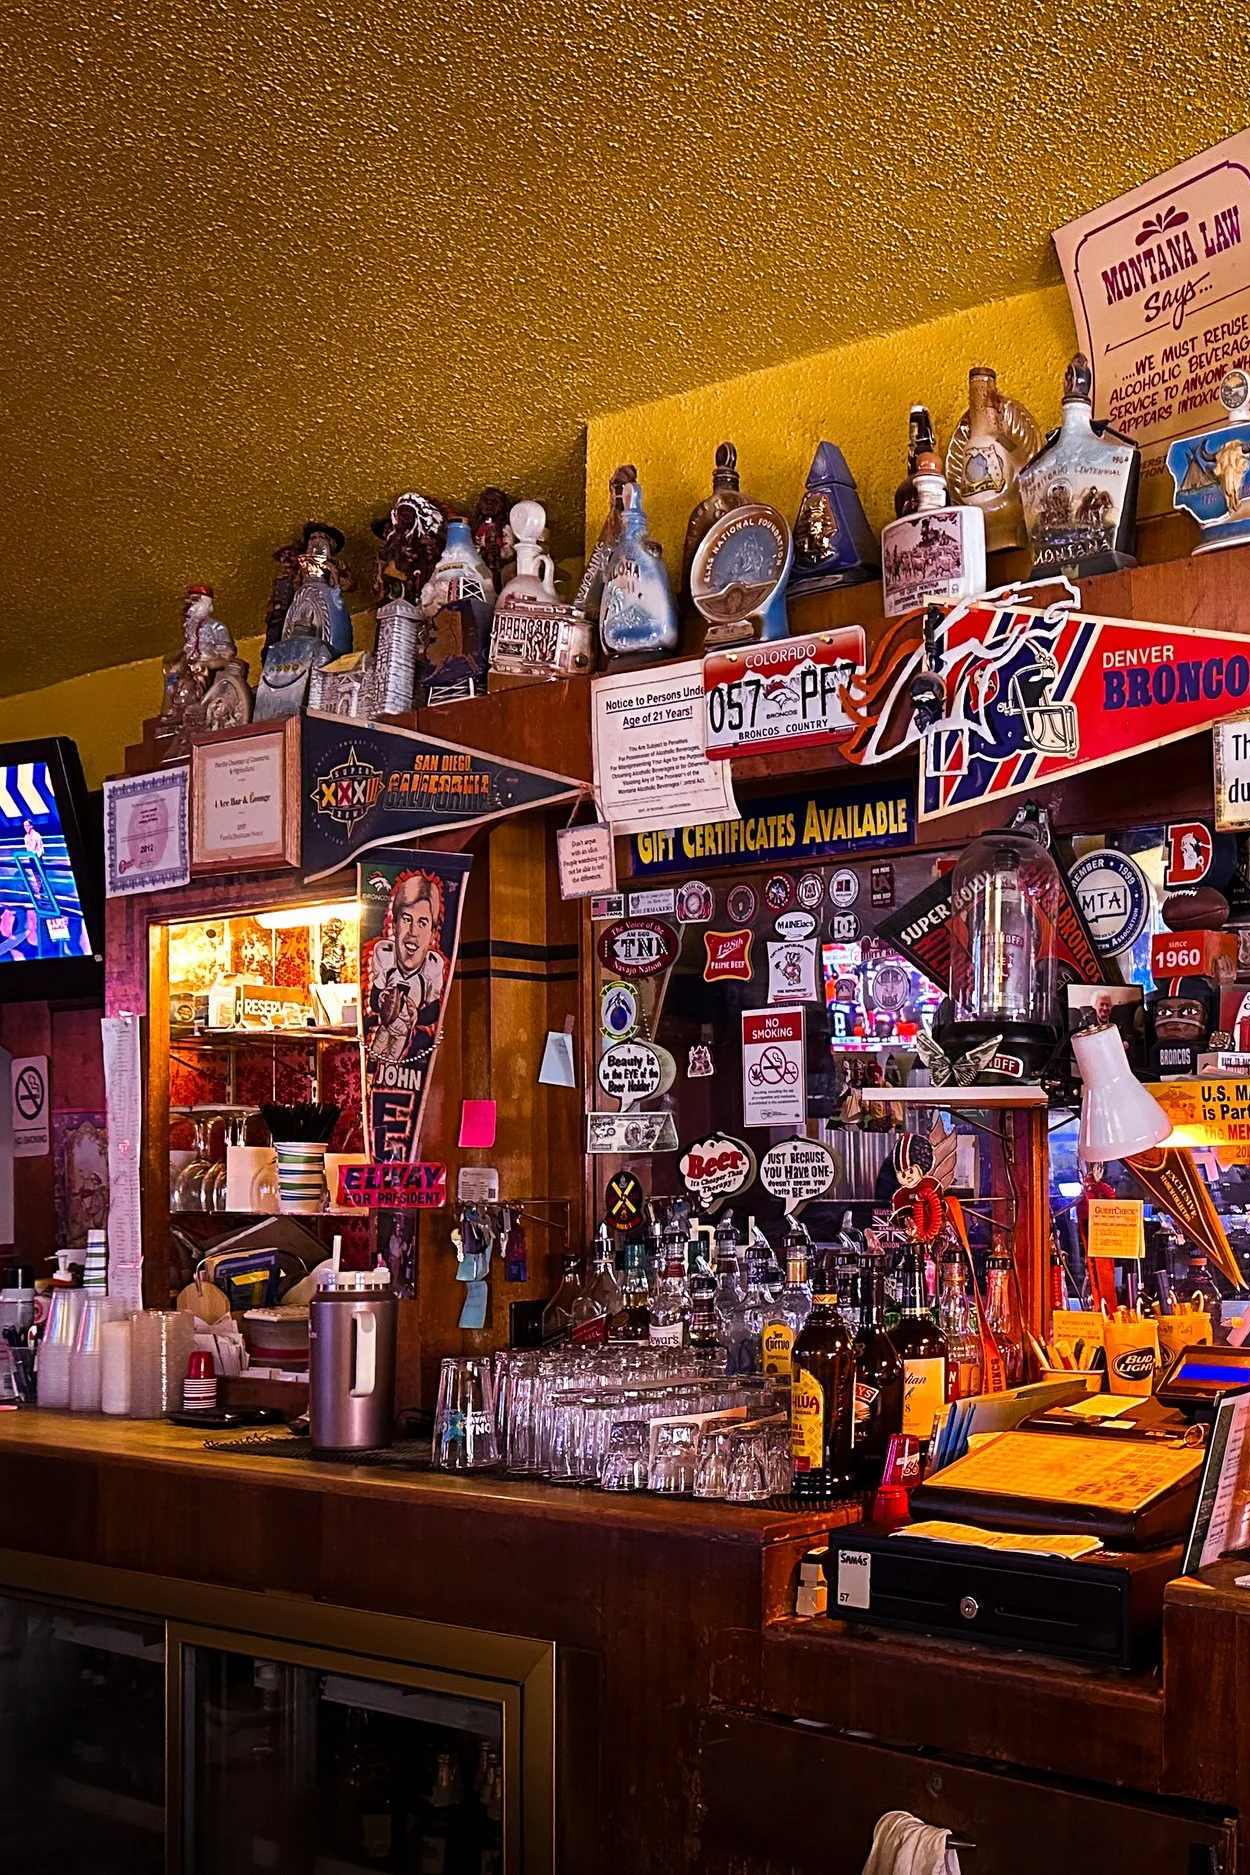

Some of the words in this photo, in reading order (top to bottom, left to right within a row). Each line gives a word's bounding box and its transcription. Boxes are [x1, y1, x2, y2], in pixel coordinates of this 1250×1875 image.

[1101, 231, 1192, 306] MONTANA
[1200, 206, 1242, 259] LAW
[1161, 336, 1198, 366] MUST
[1203, 315, 1249, 345] REFUSE
[1108, 396, 1158, 422] SERVICE
[1164, 384, 1179, 401] TO
[1182, 363, 1226, 396] ANYONE
[1110, 367, 1181, 404] ALCOHOLIC
[1119, 410, 1172, 434] APPEARS
[704, 557, 713, 582] ELKS
[712, 519, 754, 554] NATIONAL
[758, 518, 783, 566] FOUNDATION
[746, 644, 816, 668] COLORADO
[1103, 645, 1175, 669] DENVER
[606, 699, 634, 711] Notice
[636, 697, 644, 705] to
[646, 691, 681, 704] Persons
[708, 678, 762, 733] 057
[623, 714, 640, 727] Age
[643, 712, 651, 723] of
[653, 711, 663, 720] 21
[665, 706, 693, 719] Years!
[766, 709, 798, 719] BRONCOS
[739, 727, 780, 741] BRONCOS
[786, 719, 828, 733] COUNTRY
[415, 755, 439, 771] SAN
[335, 767, 370, 777] SUPER
[637, 828, 674, 865] GIFT
[682, 812, 795, 859] CERTIFICATES
[803, 799, 907, 845] AVAILABLE
[1117, 862, 1136, 886] 1999
[1081, 892, 1122, 912] MTA
[901, 904, 951, 946] SUPER
[1168, 939, 1188, 948] since
[1155, 949, 1201, 968] 1960
[613, 961, 636, 975] Navajo
[639, 961, 661, 972] Nation
[766, 1018, 779, 1027] NO
[752, 1028, 793, 1039] SMOKING
[608, 1055, 643, 1068] Beauty
[647, 1055, 655, 1066] is
[1159, 1047, 1191, 1066] BRONCOS
[376, 1064, 422, 1091] JOHN
[612, 1069, 623, 1078] the
[624, 1069, 639, 1078] EYE
[608, 1082, 626, 1093] Beer
[628, 1079, 654, 1092] Holder!
[1201, 1086, 1231, 1102] U.S.
[1203, 1105, 1216, 1120] is
[24, 1135, 48, 1144] SMOKING
[768, 1153, 786, 1164] JUST
[790, 1152, 825, 1163] BECAUSE
[344, 1165, 443, 1190] ELWAY
[701, 1173, 726, 1187] Cheaper
[728, 1169, 743, 1178] Than
[764, 1167, 781, 1178] YOU
[702, 1178, 736, 1194] Therapy!
[792, 1187, 803, 1197] BE
[1165, 1170, 1197, 1218] EXCLUSIVE
[343, 1193, 373, 1206] FOR
[377, 1191, 440, 1206] PRESIDENT
[765, 1337, 790, 1351] Cuervo
[1125, 1354, 1153, 1366] BUD
[1117, 1361, 1155, 1378] LIGHT
[839, 1593, 849, 1603] 57
